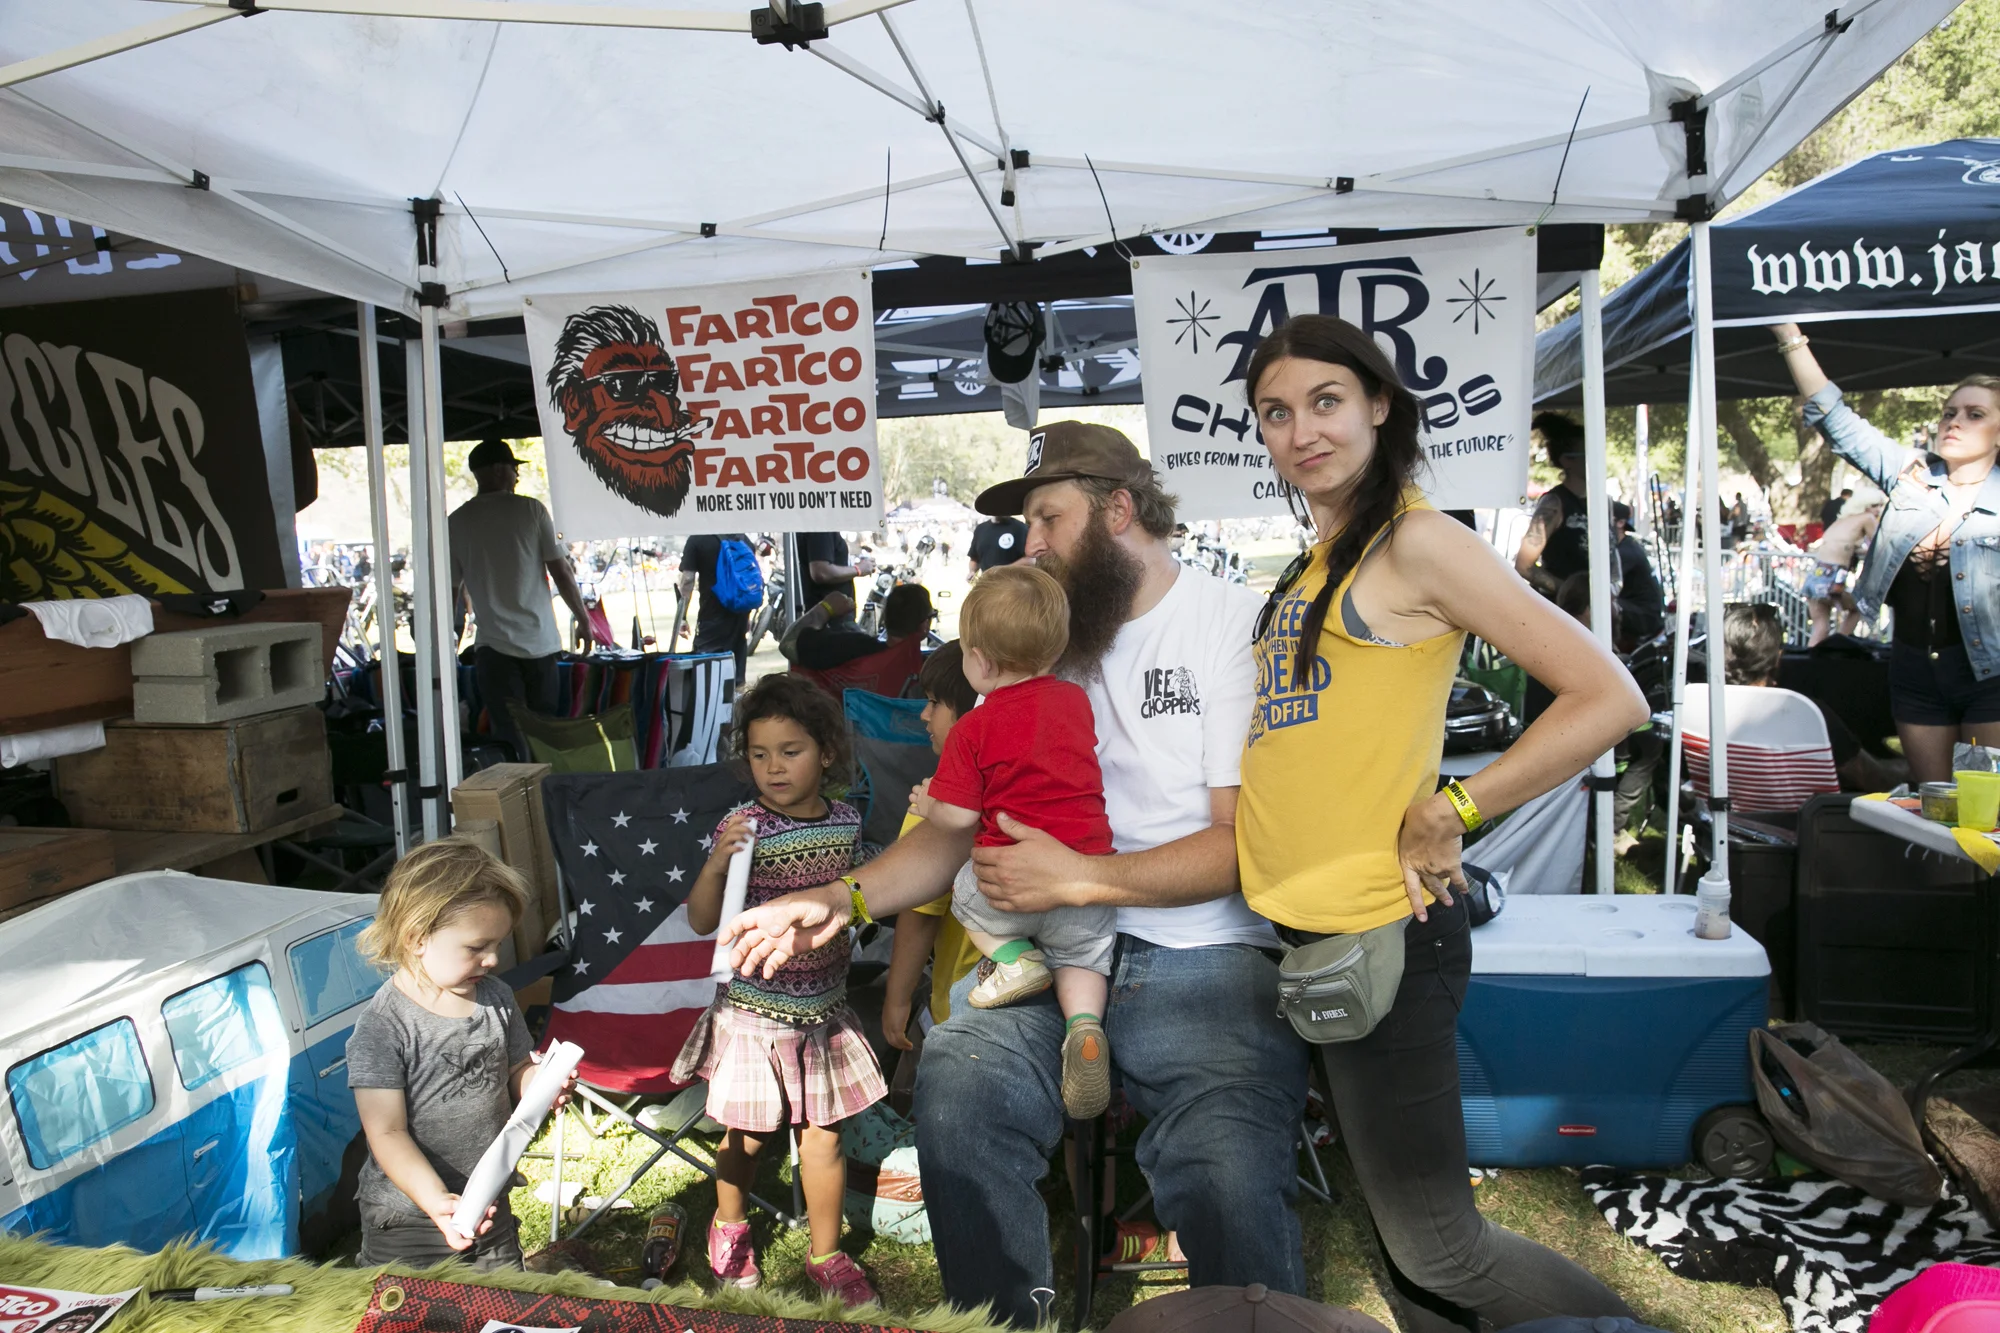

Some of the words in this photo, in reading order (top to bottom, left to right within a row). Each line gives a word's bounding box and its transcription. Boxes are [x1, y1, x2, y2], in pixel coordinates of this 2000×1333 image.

[666, 294, 859, 346] FARTCO
[675, 343, 862, 393] FARTCO
[686, 392, 867, 440] FARTCO
[692, 442, 870, 488] FARTCO
[1204, 451, 1240, 466] FROM
[1243, 453, 1267, 469] THE
[1428, 441, 1453, 460] THE
[696, 494, 733, 512] MORE
[736, 492, 766, 510] SHIT
[769, 492, 795, 510] YOU
[799, 491, 837, 508] DON'T
[840, 490, 872, 508] NEED
[1144, 668, 1176, 700] VEE
[1140, 697, 1201, 719] CHOPPERS
[1270, 699, 1314, 725] DFFL
